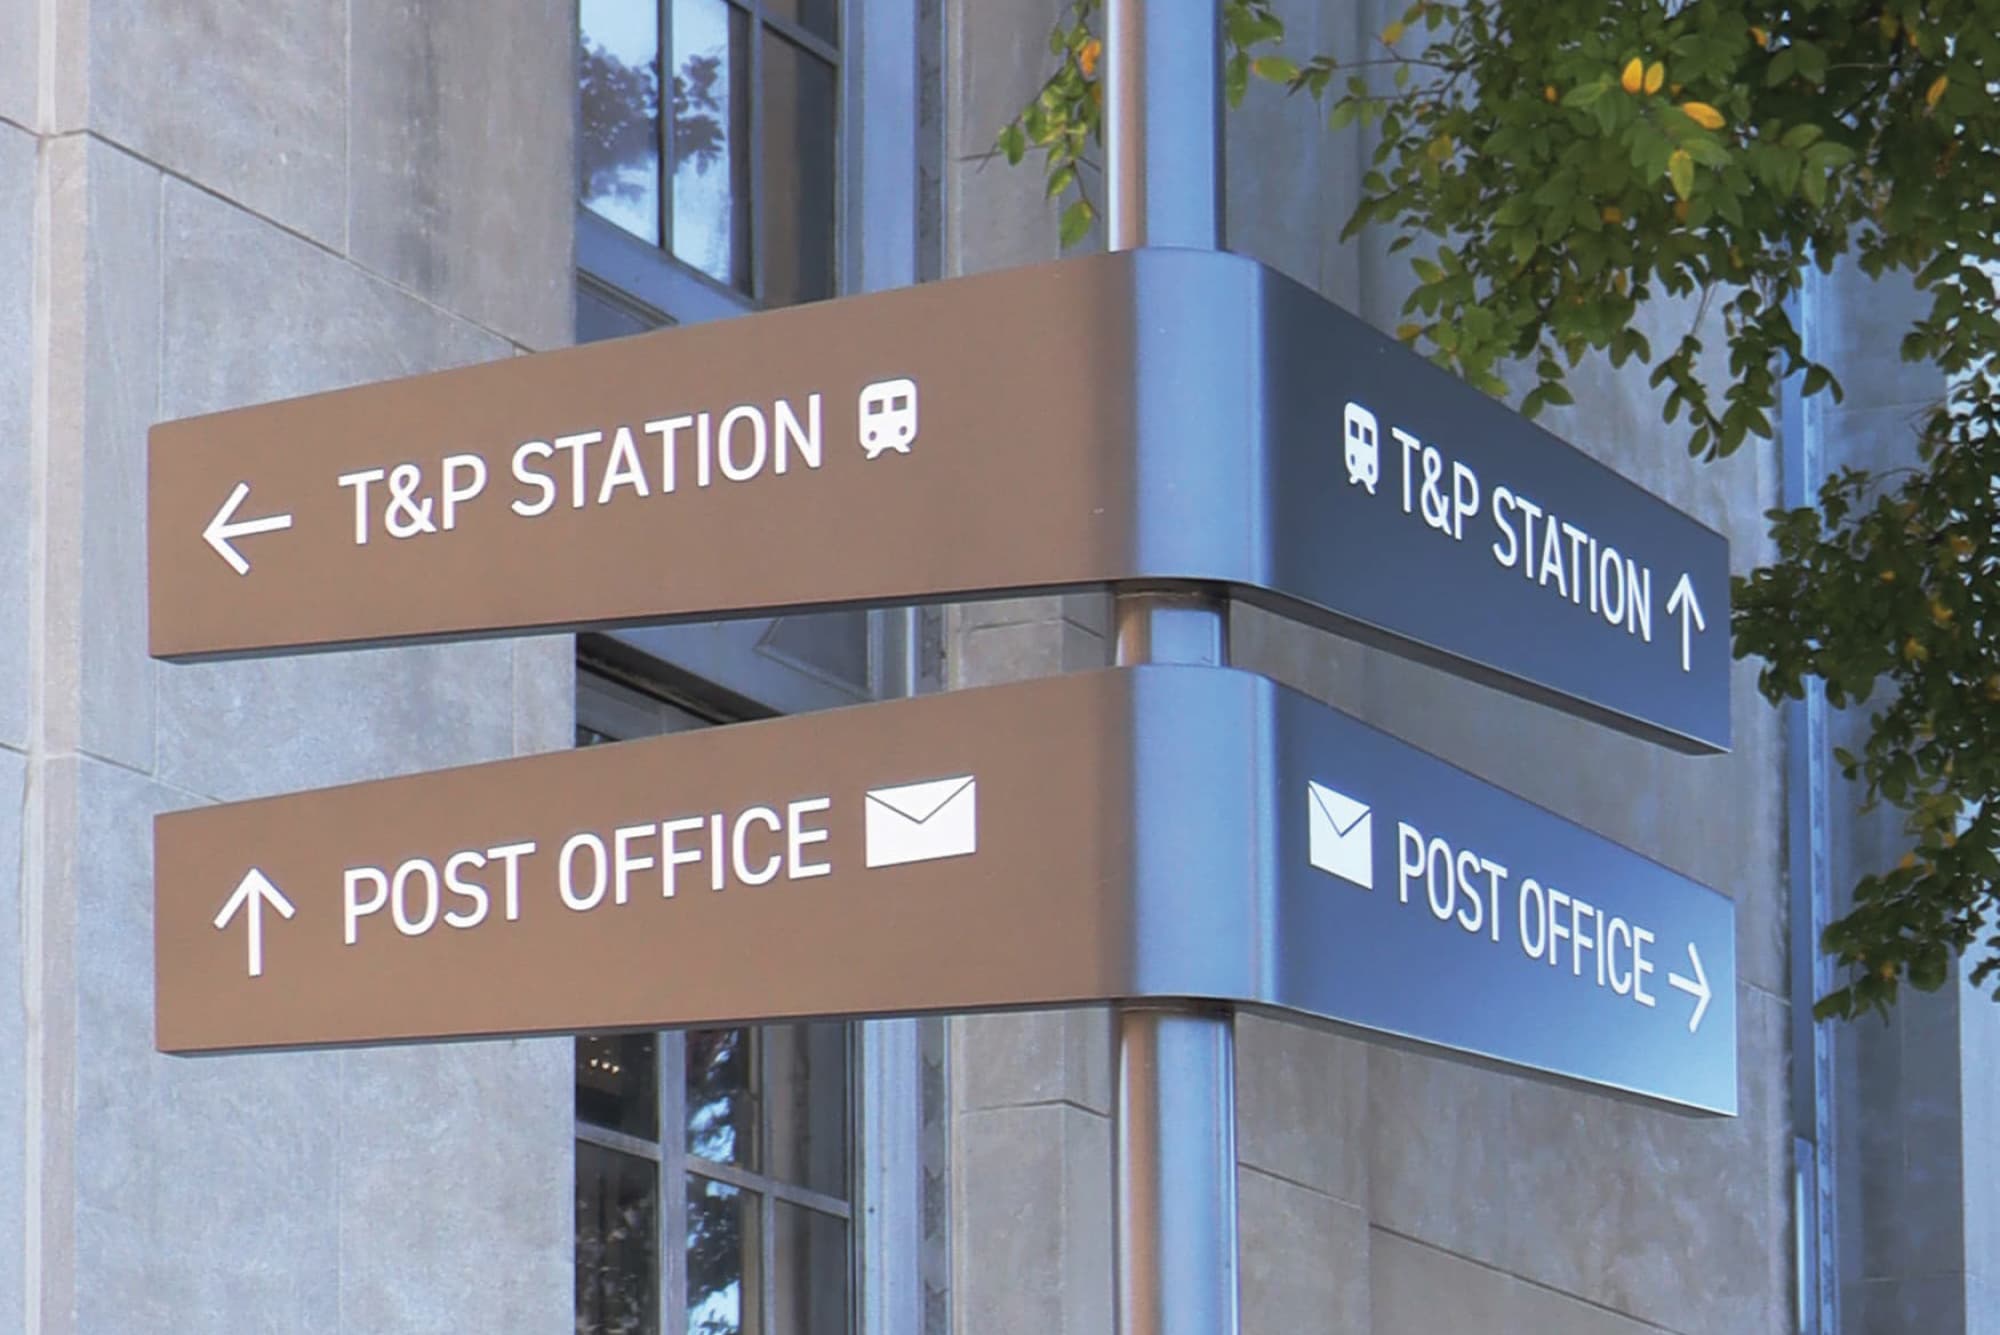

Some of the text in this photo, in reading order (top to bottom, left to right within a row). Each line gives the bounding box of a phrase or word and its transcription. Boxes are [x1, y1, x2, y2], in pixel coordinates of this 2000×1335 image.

[338, 393, 821, 545] T&P STATION
[1391, 427, 1651, 642] T&P STATION
[344, 797, 831, 945] POST OFFICE
[1398, 822, 1655, 1006] POST OFFICE
